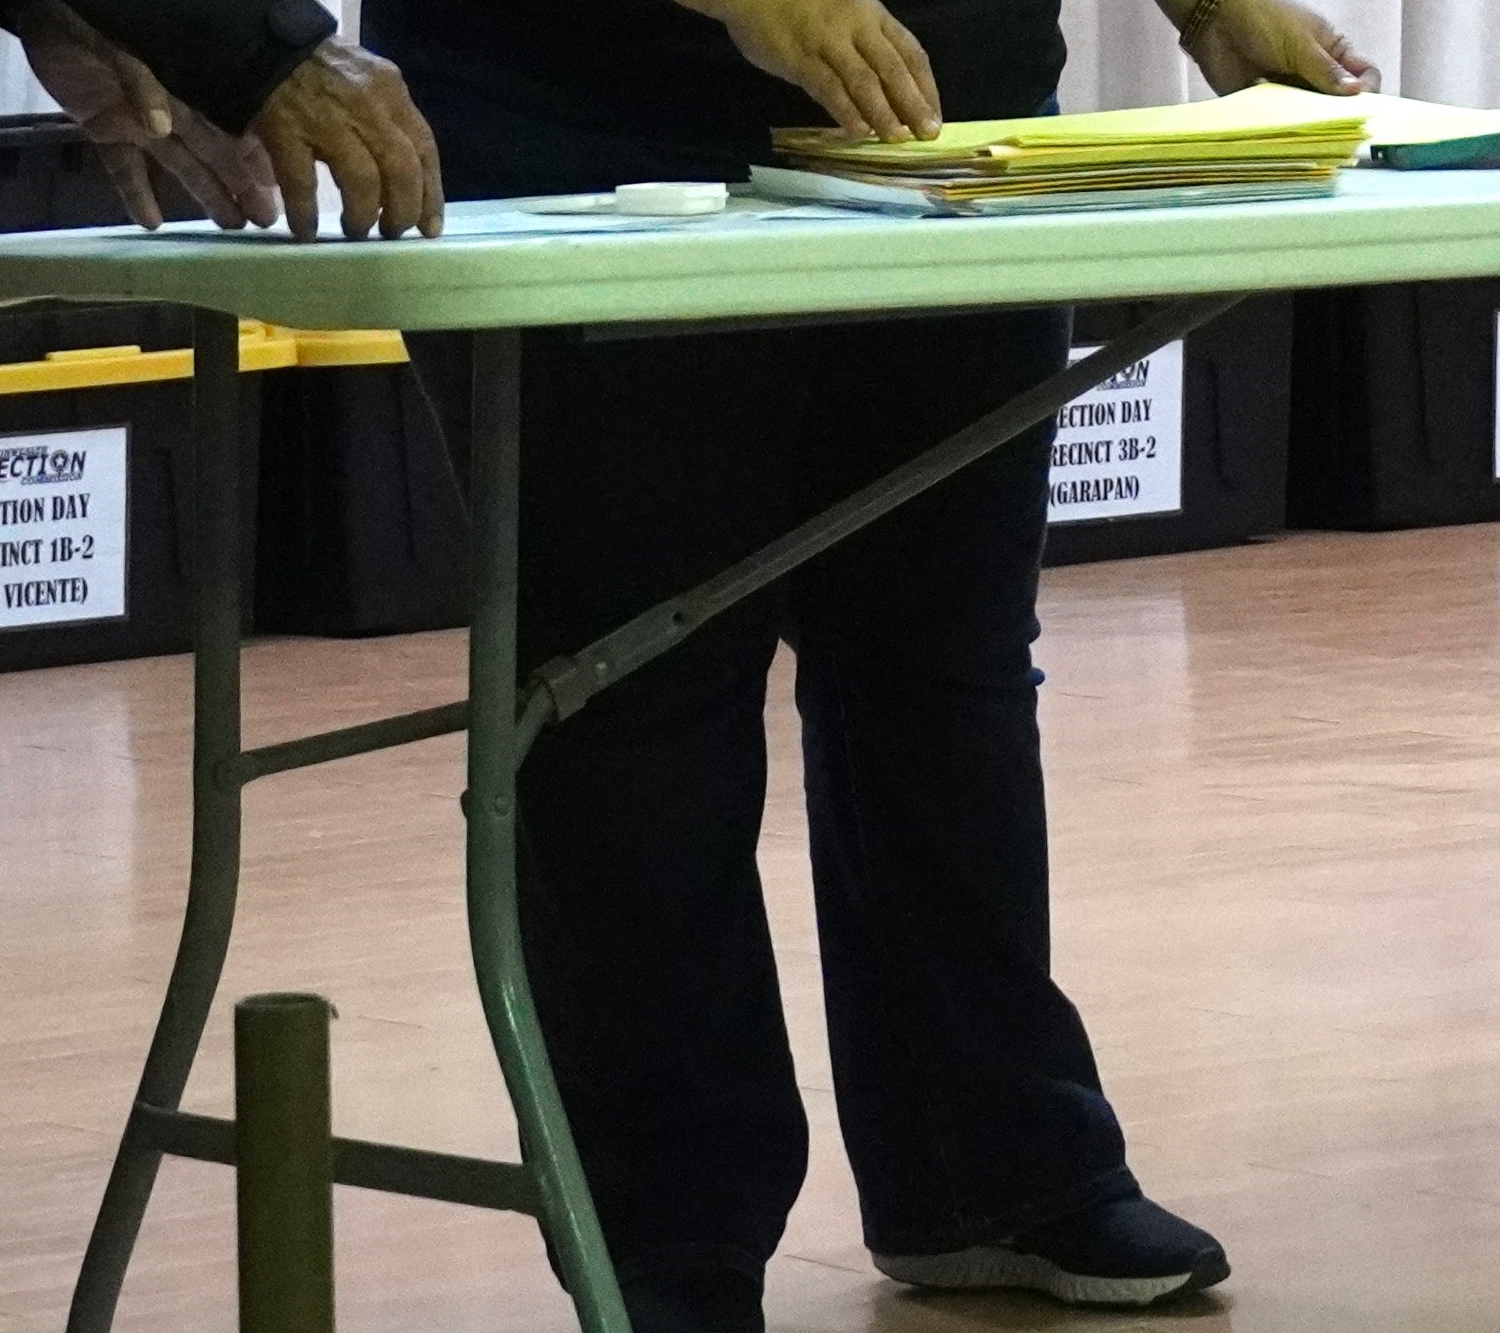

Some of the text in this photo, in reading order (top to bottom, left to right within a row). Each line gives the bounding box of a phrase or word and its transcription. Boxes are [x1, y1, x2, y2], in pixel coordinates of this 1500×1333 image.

[1059, 398, 1153, 429] ECTION DAY
[1050, 435, 1156, 467] RECINCT 3B-2
[1050, 475, 1140, 507] (GARAPAN)
[52, 493, 90, 521] DAY
[50, 534, 95, 564] 1B-2
[4, 577, 89, 610] VICENTE)
